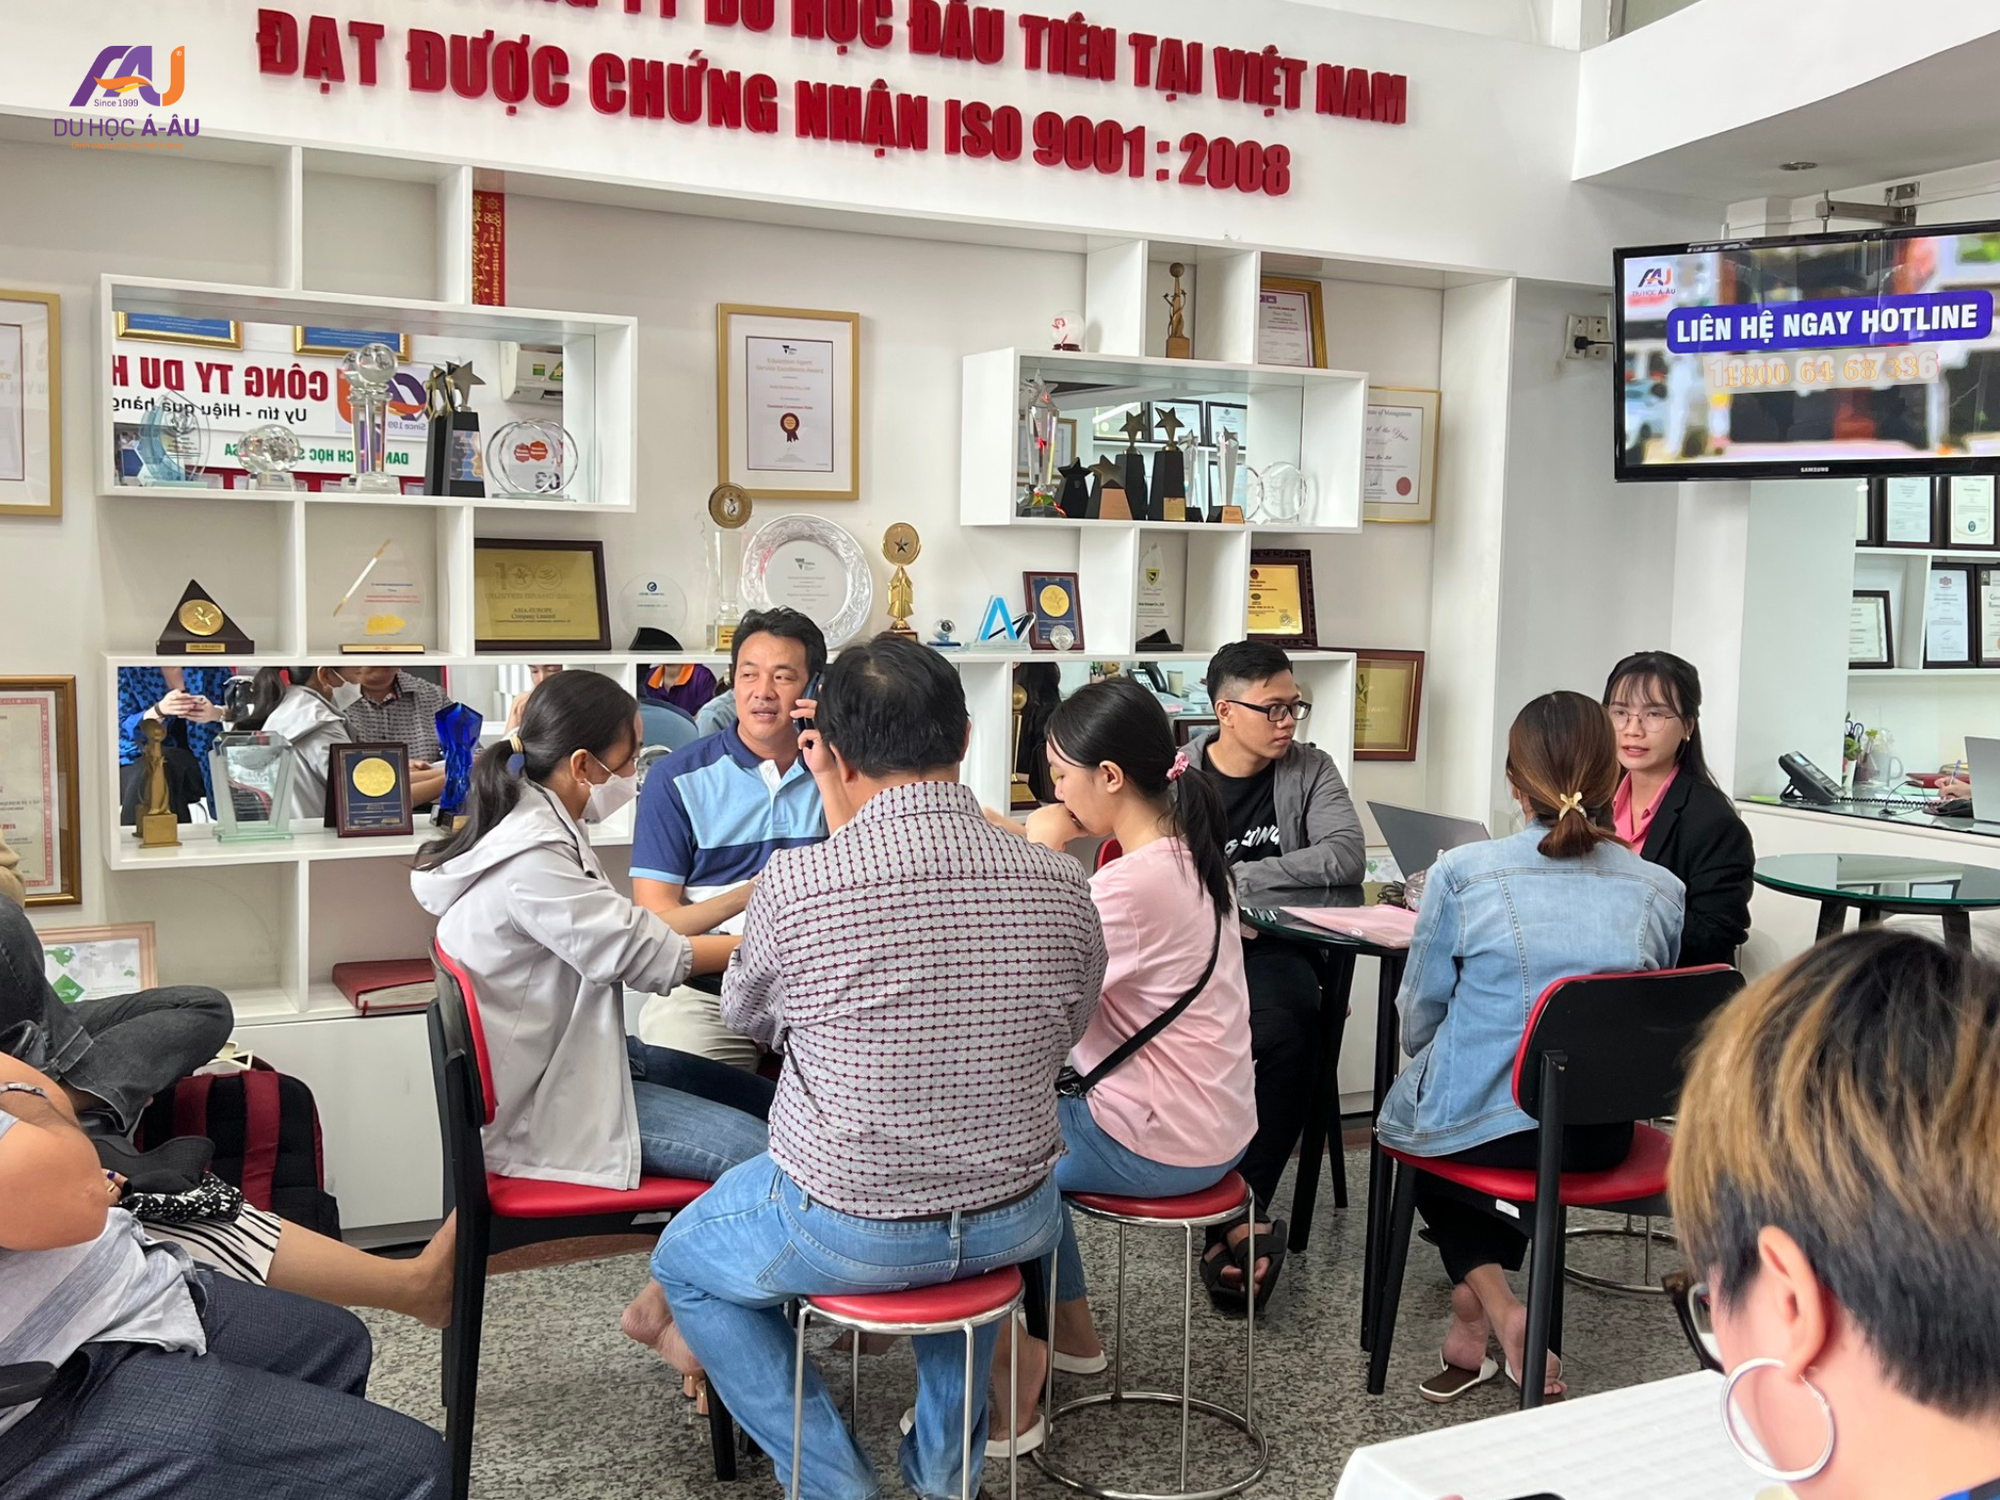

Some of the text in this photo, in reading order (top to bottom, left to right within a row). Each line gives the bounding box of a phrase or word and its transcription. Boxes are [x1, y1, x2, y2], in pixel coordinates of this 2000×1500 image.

[256, 8, 386, 94] ĐẠT
[406, 29, 571, 116] ĐƯỢC
[589, 49, 778, 134] CHỨNG
[794, 79, 929, 159] NHẬN
[944, 99, 1023, 162] ISO
[1018, 12, 1117, 82] TIÊN
[1128, 33, 1203, 102] TẠI
[1213, 44, 1307, 117] VIỆT
[1316, 64, 1406, 124] NAM
[1677, 303, 1978, 344] LIÊN HỆ NGAY HOTLINE
